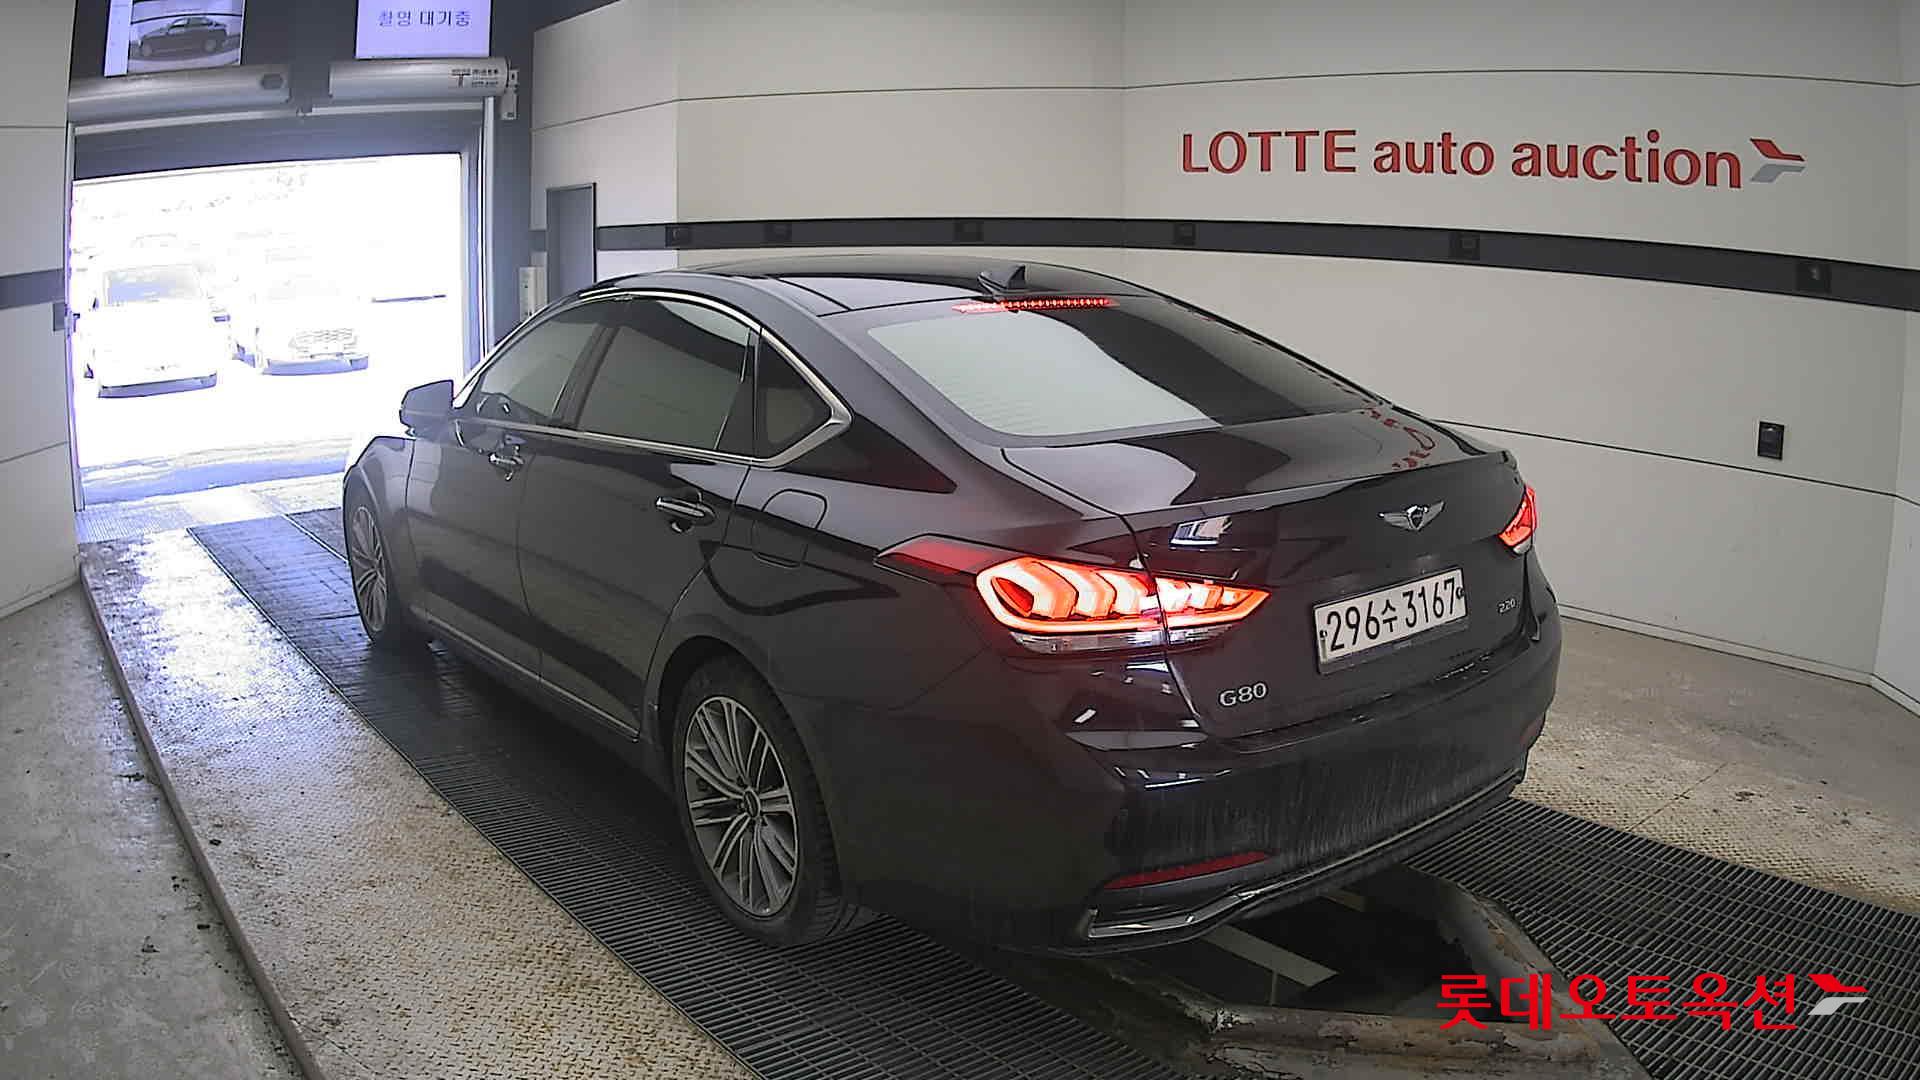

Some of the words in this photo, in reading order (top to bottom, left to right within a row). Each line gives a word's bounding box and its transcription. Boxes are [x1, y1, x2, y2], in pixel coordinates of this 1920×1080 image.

[419, 10, 471, 27] 대기중
[1182, 129, 1357, 174] LOTTE
[1373, 131, 1495, 176] auto
[1511, 129, 1742, 189] auction
[1326, 577, 1456, 652] 296수3167
[1219, 682, 1267, 707] G80
